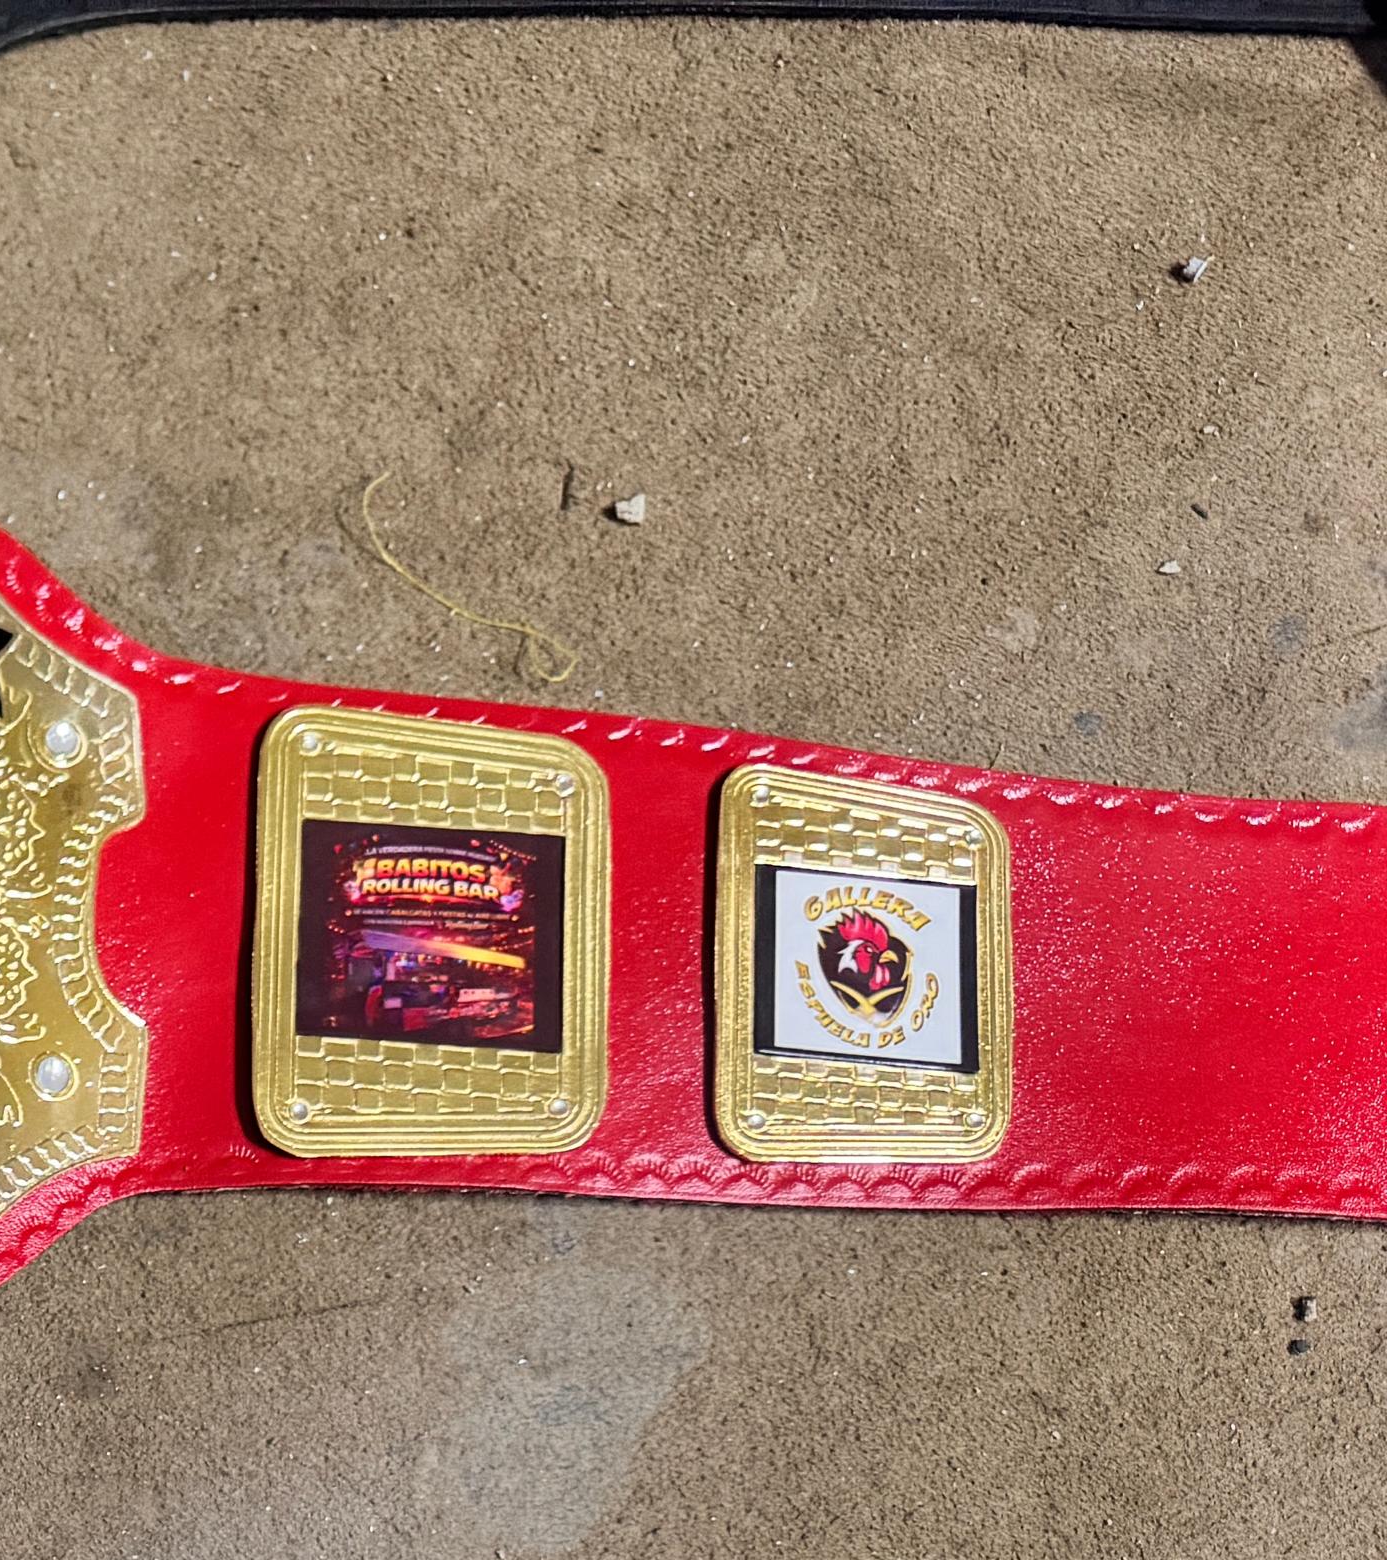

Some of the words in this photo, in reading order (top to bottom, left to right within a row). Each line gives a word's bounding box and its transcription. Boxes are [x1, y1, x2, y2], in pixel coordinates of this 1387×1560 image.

[378, 858, 486, 882] BABITOS
[362, 878, 450, 895] ROLLING
[453, 881, 500, 901] BAR
[804, 886, 932, 931] GALLERA
[795, 959, 870, 1048] ESPUELA
[877, 1025, 905, 1048] DE
[911, 973, 939, 1032] ORO
